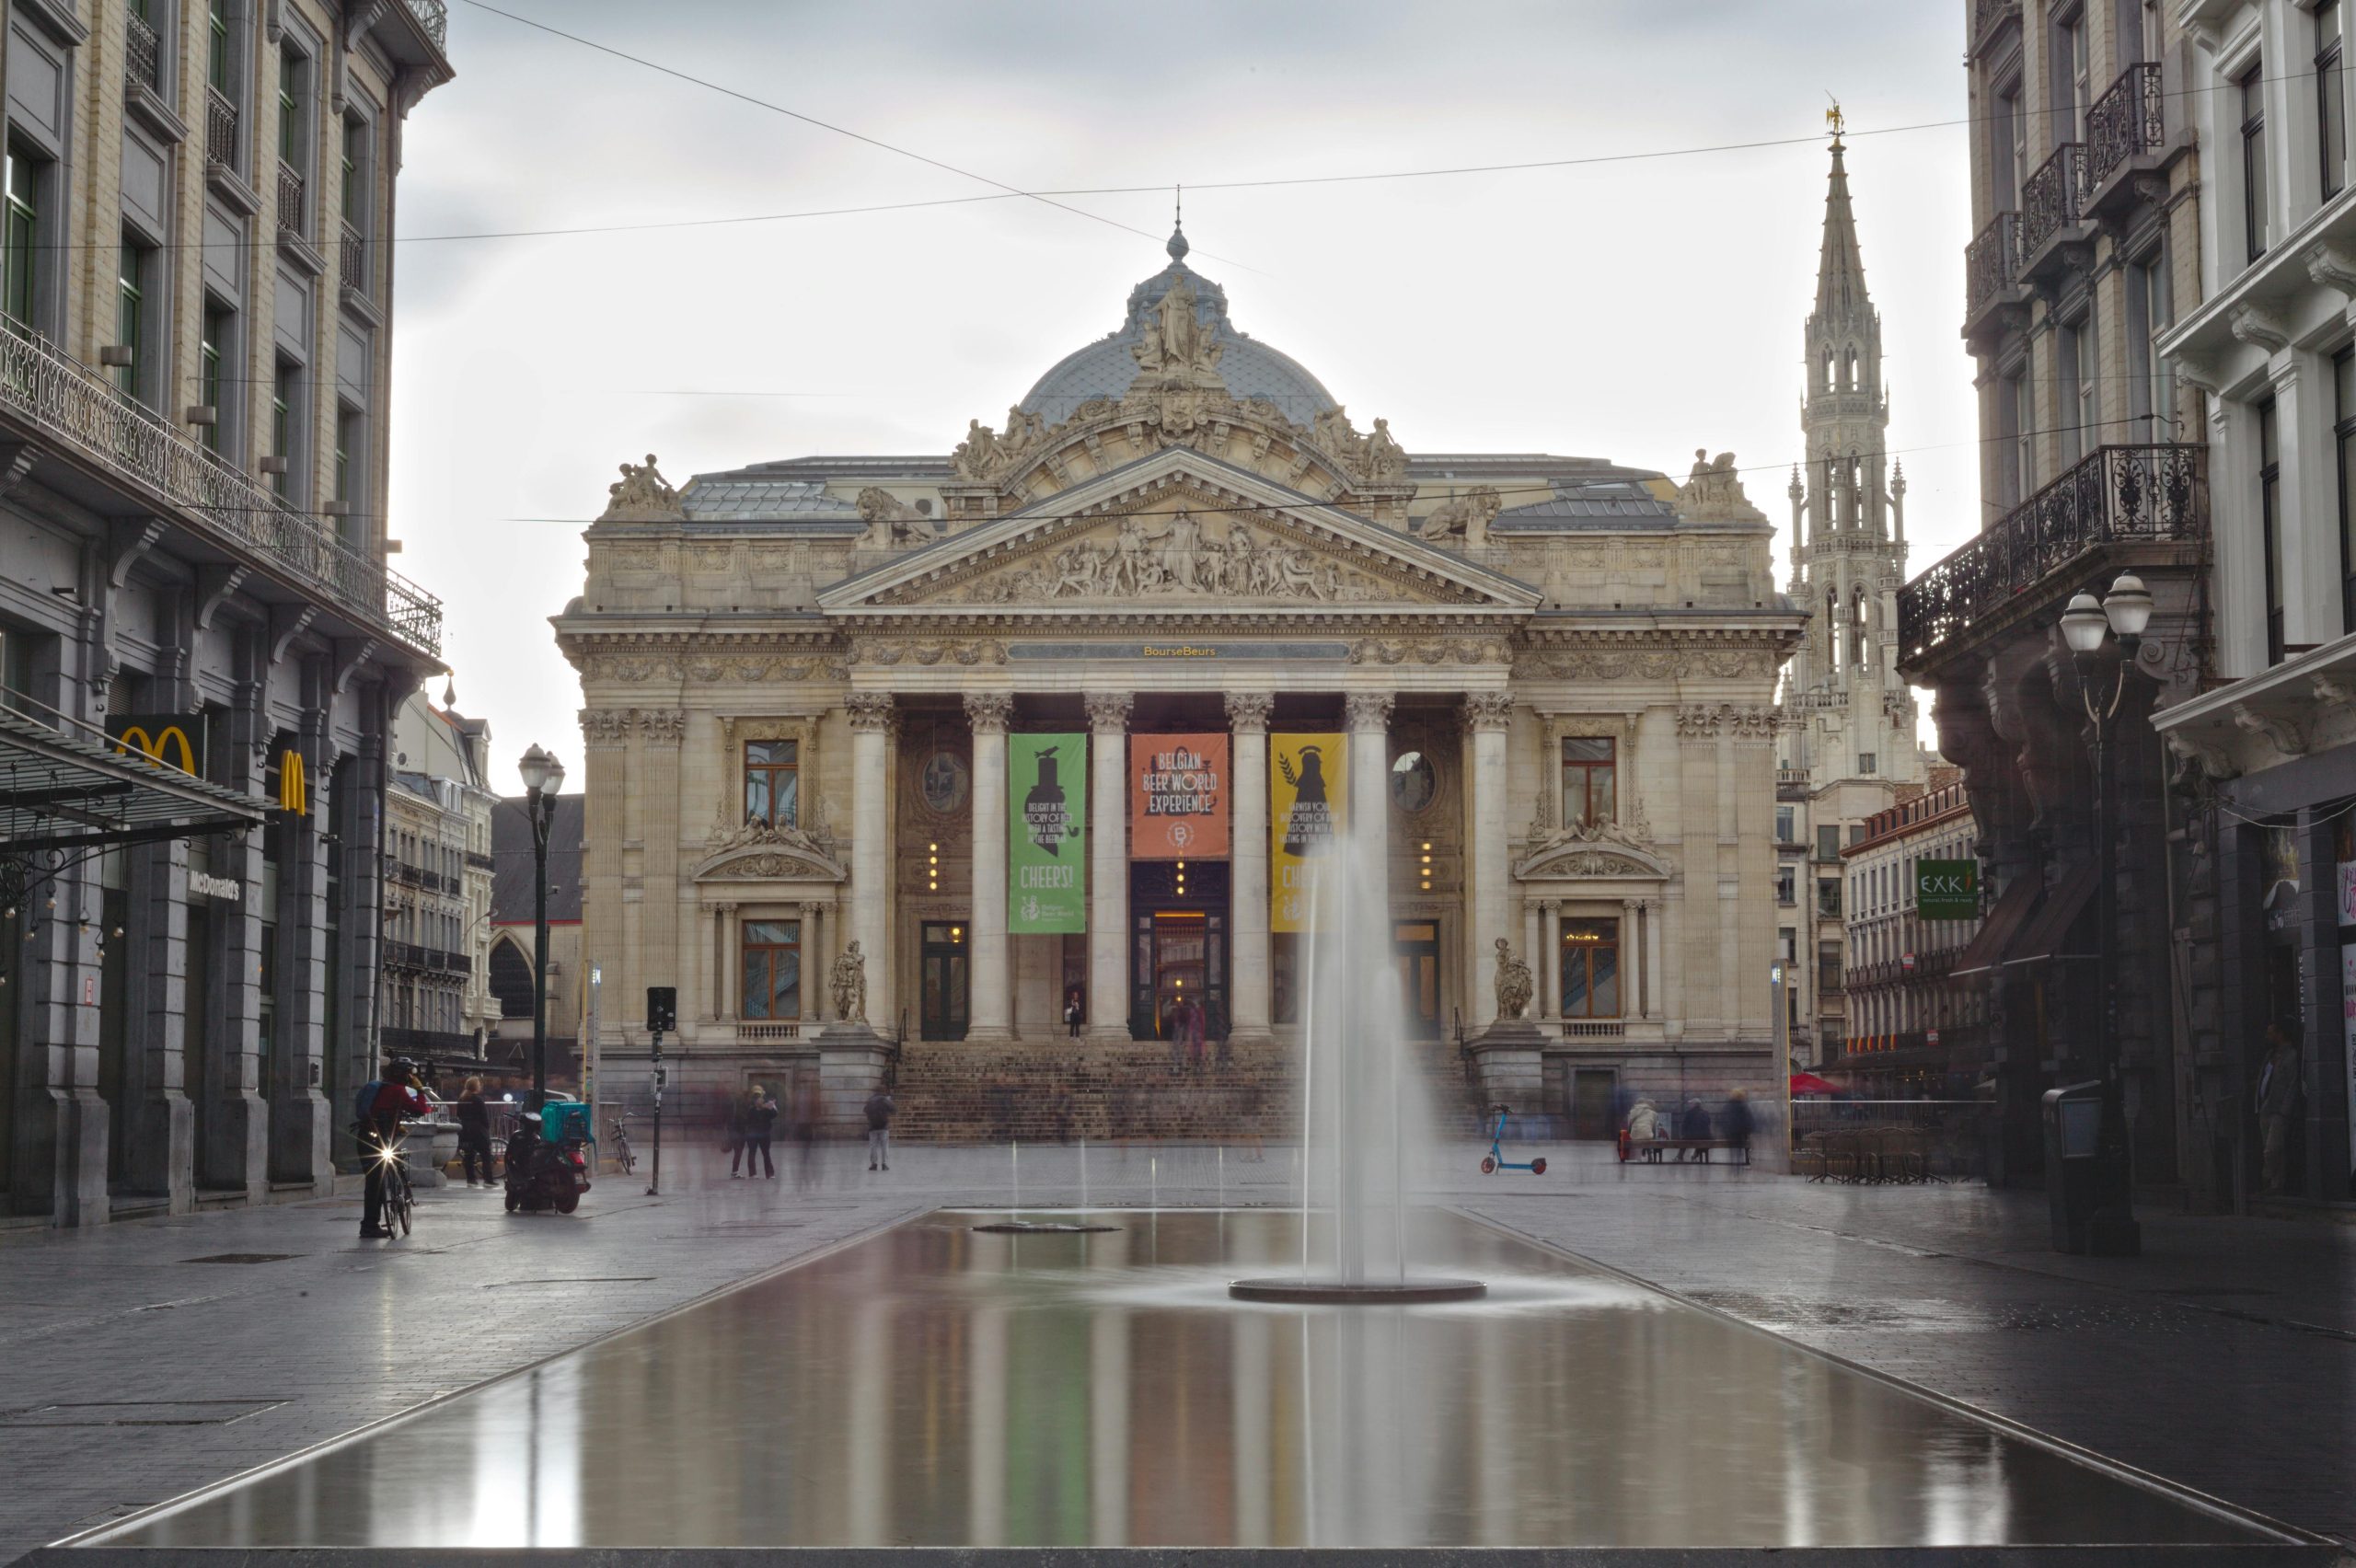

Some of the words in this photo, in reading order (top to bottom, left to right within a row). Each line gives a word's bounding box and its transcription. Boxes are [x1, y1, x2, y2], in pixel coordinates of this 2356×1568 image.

[1144, 646, 1216, 656] BourseBeurs
[1142, 774, 1169, 791] BEER
[1172, 773, 1218, 791] WORLD
[1048, 813, 1059, 823] OF
[1042, 824, 1047, 833] A
[1021, 865, 1074, 889] CHEERS!
[190, 870, 239, 901] McDonald's
